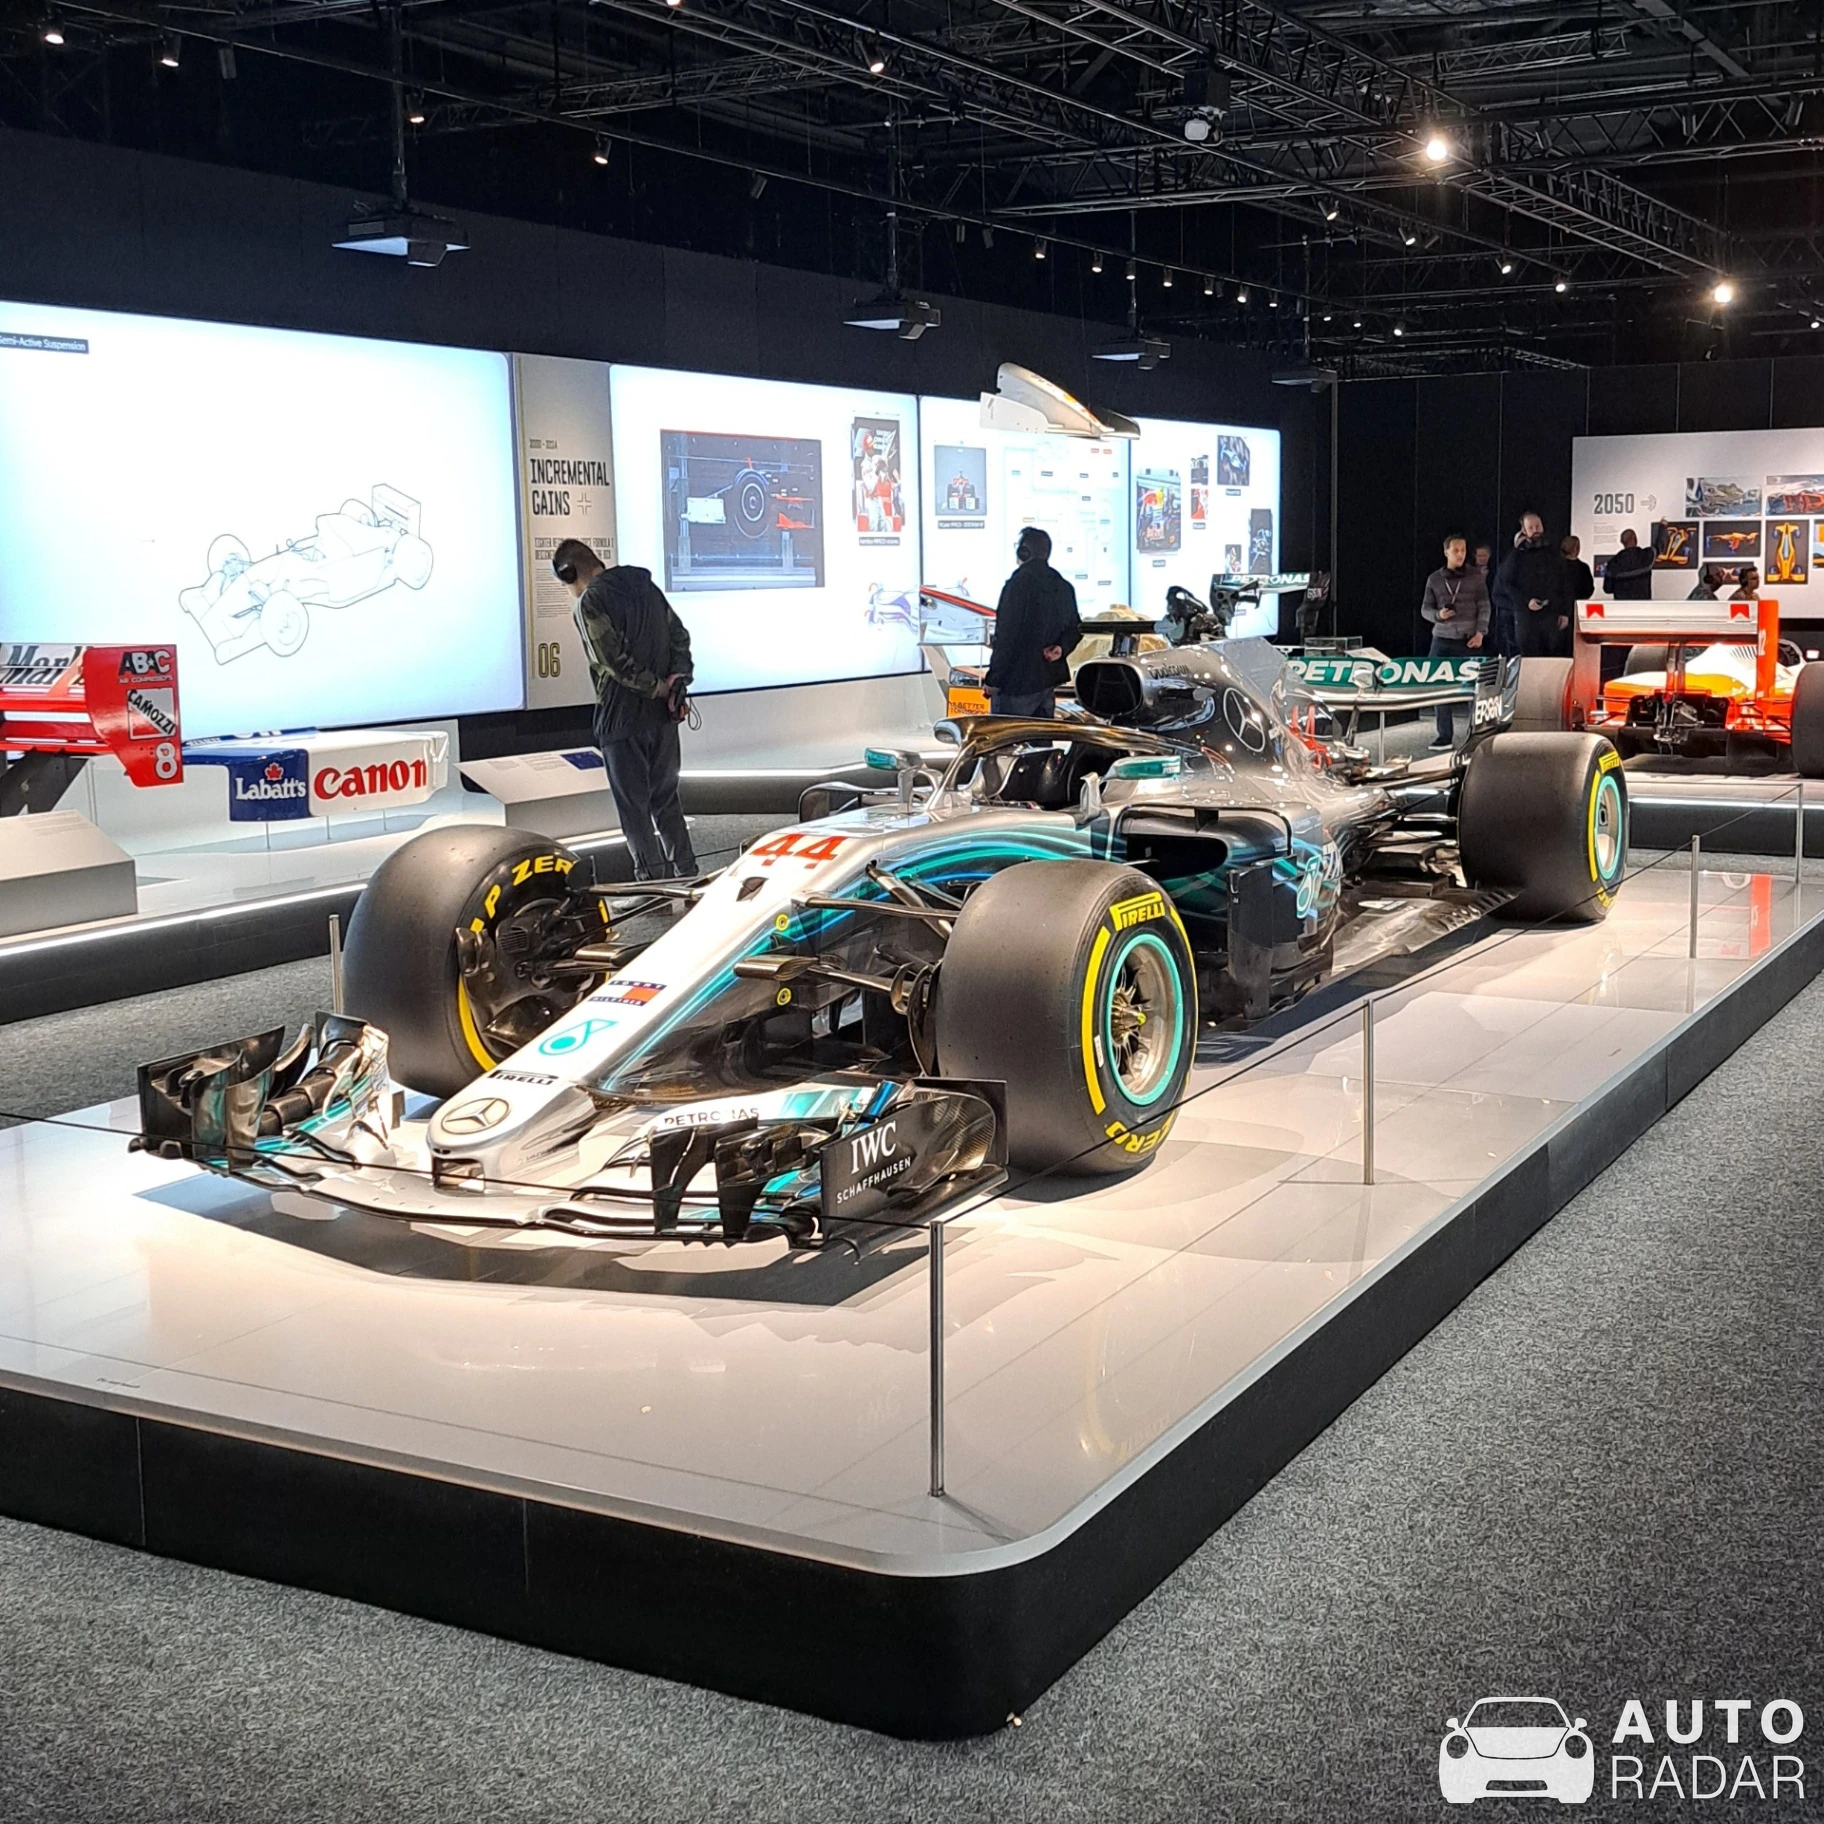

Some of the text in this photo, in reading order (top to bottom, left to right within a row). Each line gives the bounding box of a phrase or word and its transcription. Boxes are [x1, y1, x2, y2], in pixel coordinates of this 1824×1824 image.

[43, 338, 87, 351] Suspension
[530, 458, 610, 487] INCREMENTAL
[532, 490, 571, 516] GAINS
[1593, 493, 1635, 515] 2050
[538, 642, 561, 679] 06
[1287, 660, 1482, 684] PETRONAS
[127, 689, 176, 736] CAMOZZI
[155, 742, 178, 779] 8
[234, 777, 306, 801] Labatt's
[314, 759, 427, 800] Canon
[750, 832, 849, 870] 44
[511, 855, 577, 887] ZER
[1108, 891, 1166, 932] PIRELLI
[487, 1069, 559, 1086] PIRELLI
[850, 1120, 897, 1175] IWC
[836, 1156, 911, 1204] SCHAFFHAUSEN
